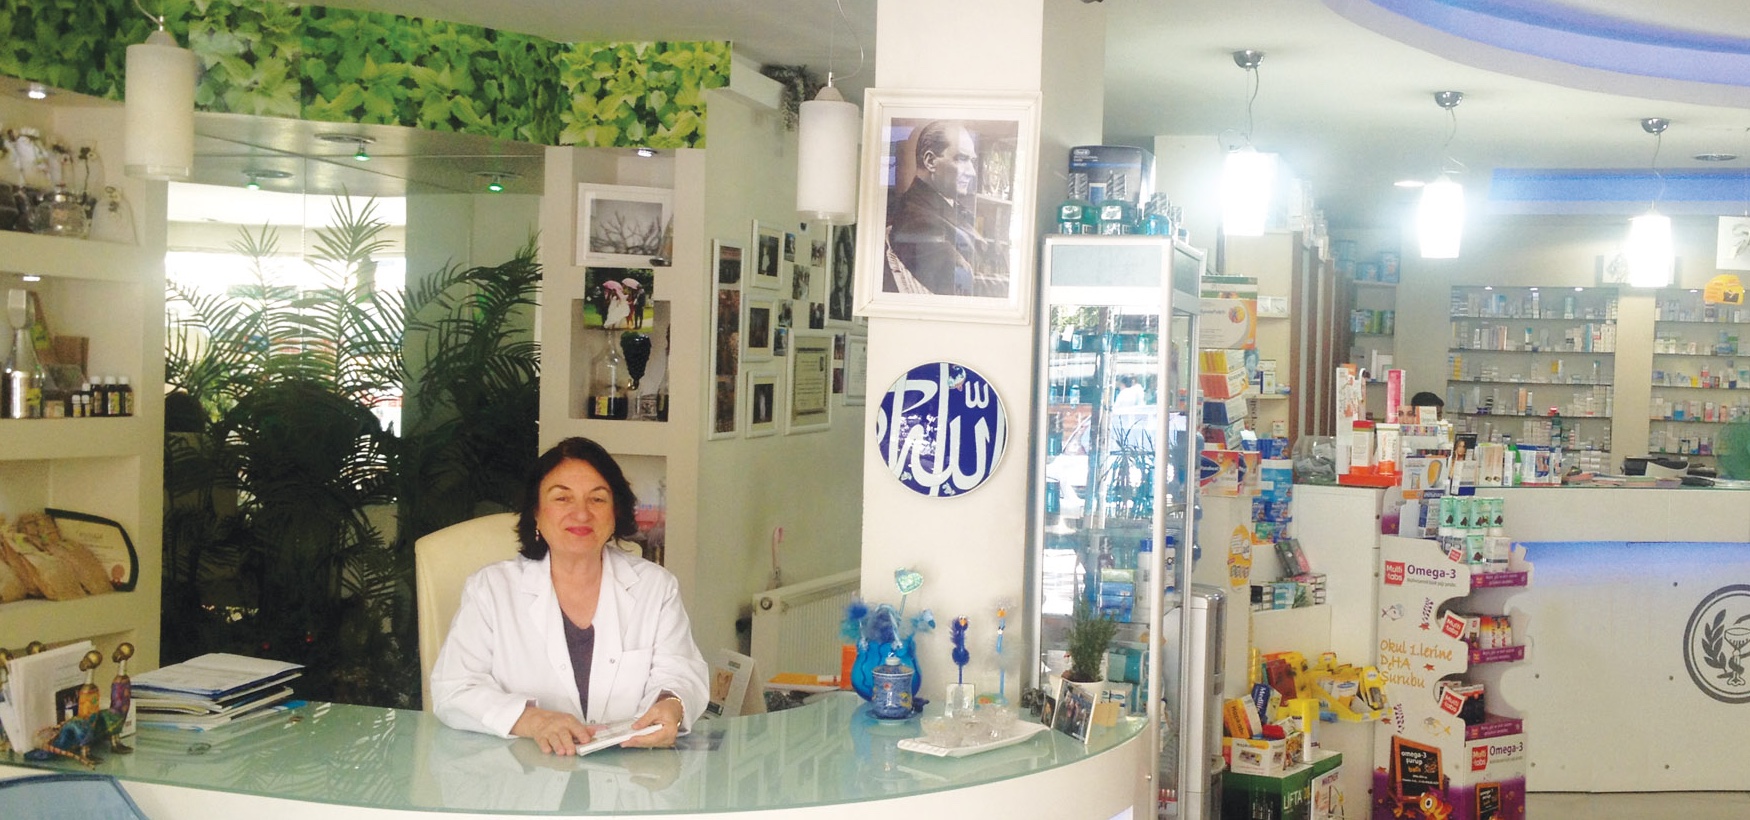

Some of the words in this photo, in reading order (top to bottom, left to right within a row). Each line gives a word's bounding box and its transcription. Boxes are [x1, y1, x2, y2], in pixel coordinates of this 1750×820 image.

[1407, 564, 1456, 579] Omega-3
[1380, 638, 1407, 654] Okul
[1381, 671, 1425, 688] Şurubu
[1401, 751, 1427, 759] omega-3
[1472, 750, 1487, 758] Multi
[1490, 742, 1524, 757] Omega-3
